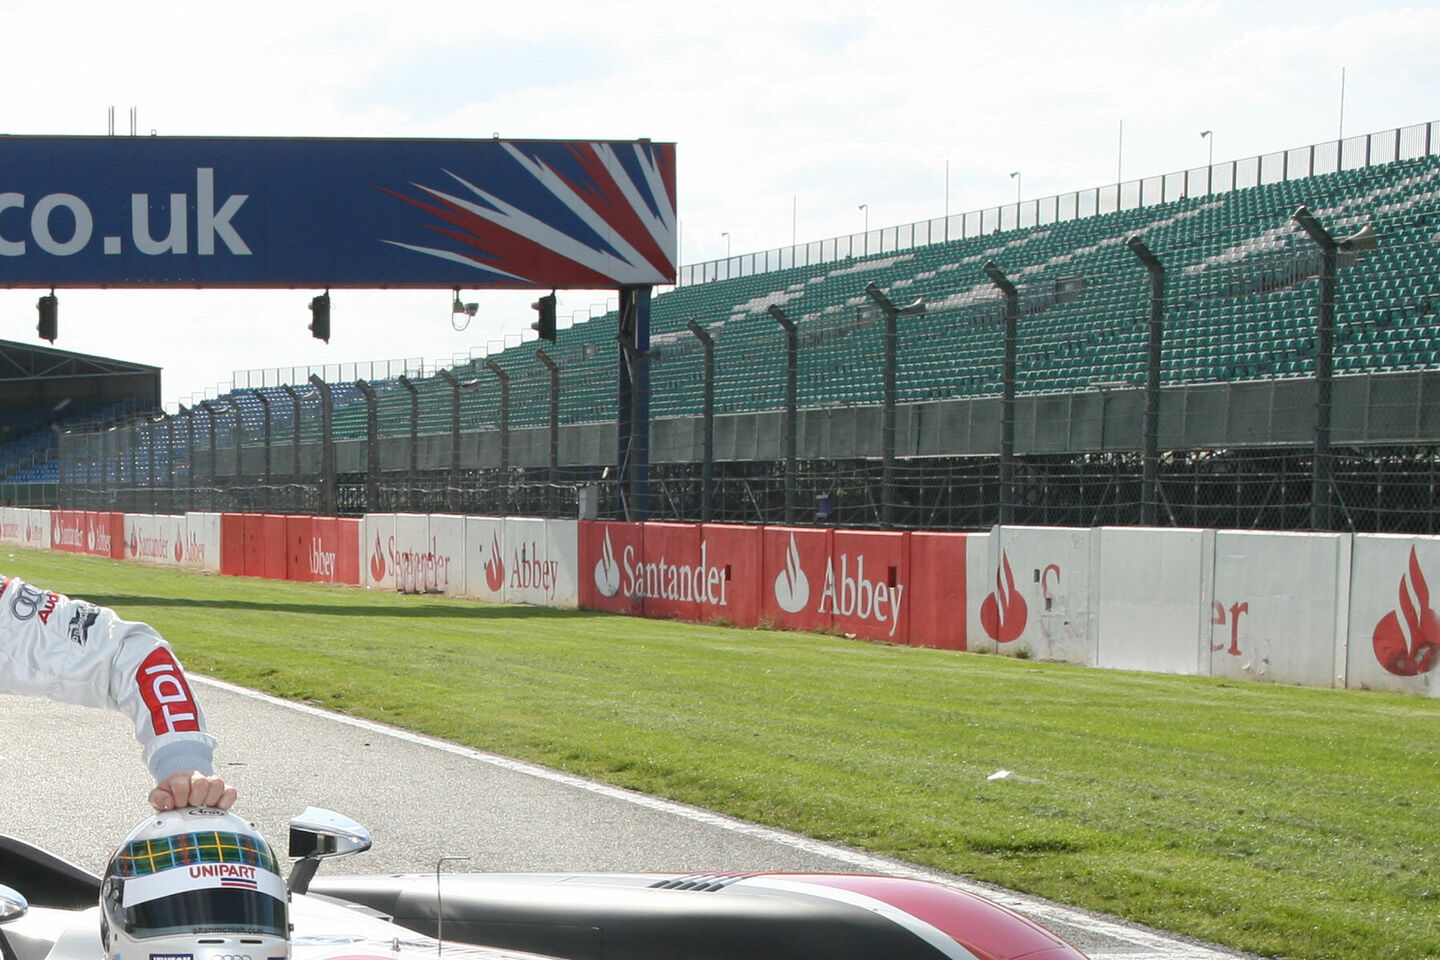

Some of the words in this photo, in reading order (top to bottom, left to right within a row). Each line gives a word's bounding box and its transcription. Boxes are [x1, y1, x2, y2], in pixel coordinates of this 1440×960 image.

[310, 537, 336, 584] bbey
[509, 541, 558, 600] Abbey
[623, 540, 728, 606] Santander
[818, 553, 904, 637] Abbey
[144, 663, 195, 732] TDI
[189, 864, 256, 880] UNIPART
